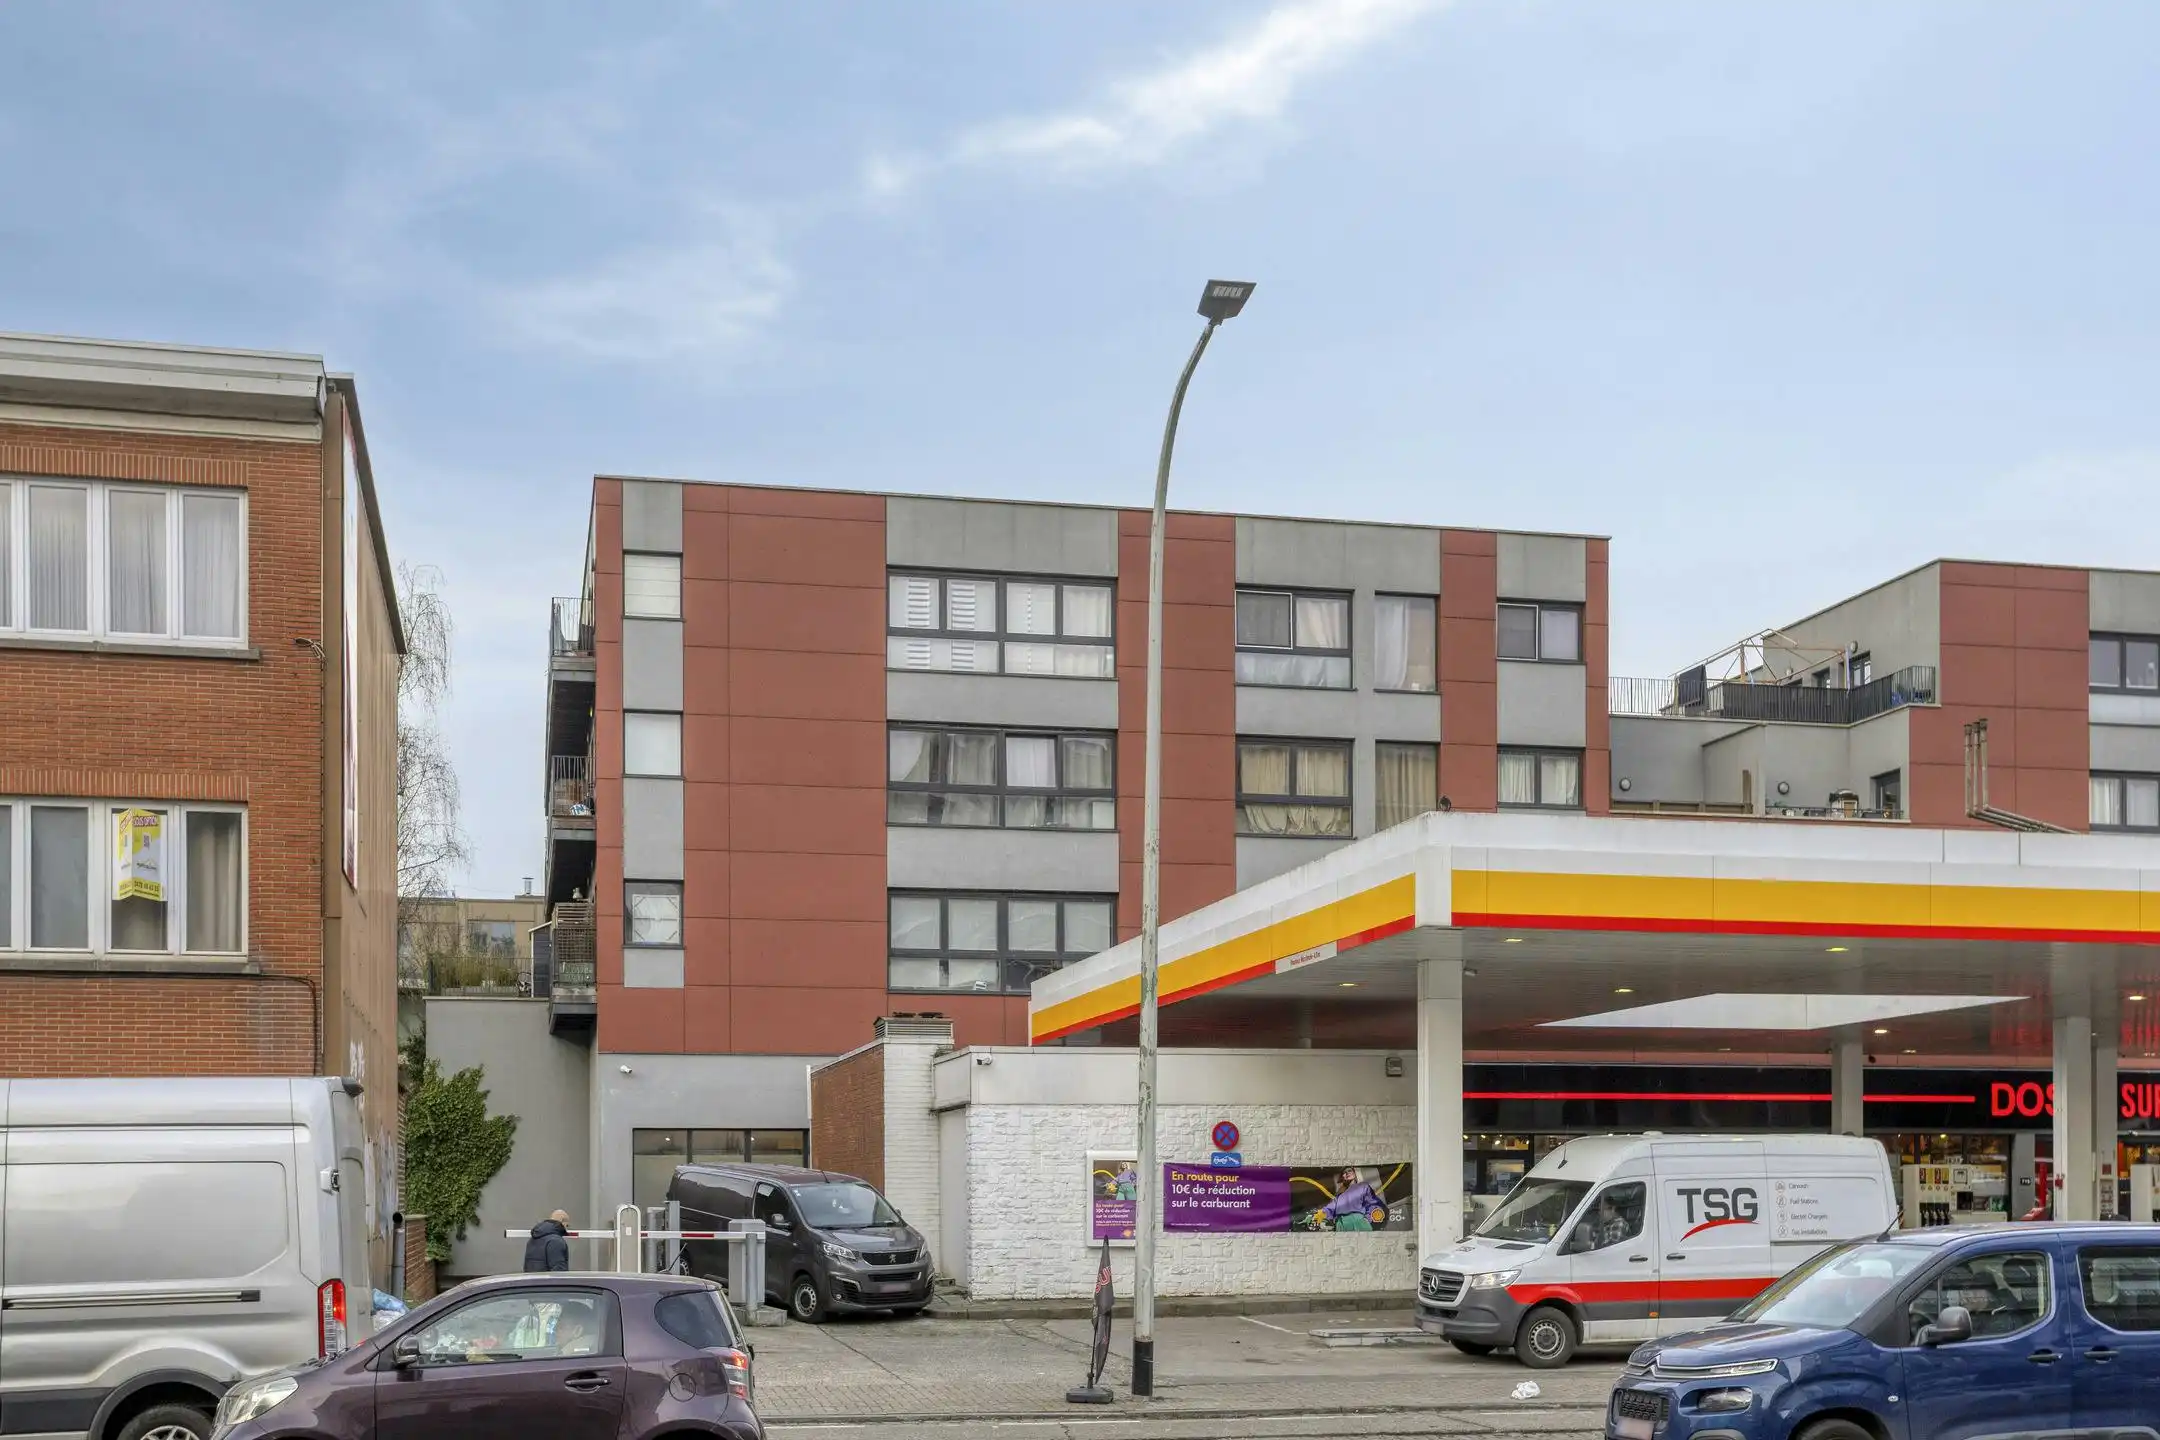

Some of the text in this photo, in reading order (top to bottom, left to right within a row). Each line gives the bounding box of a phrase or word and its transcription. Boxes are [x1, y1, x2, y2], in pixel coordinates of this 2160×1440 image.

[2121, 1083, 2160, 1117] SU
[1172, 1171, 1239, 1184] En route pour
[1172, 1184, 1255, 1195] 10€ de réduction
[1171, 1197, 1250, 1208] sur le carburant
[1677, 1188, 1758, 1223] TSG
